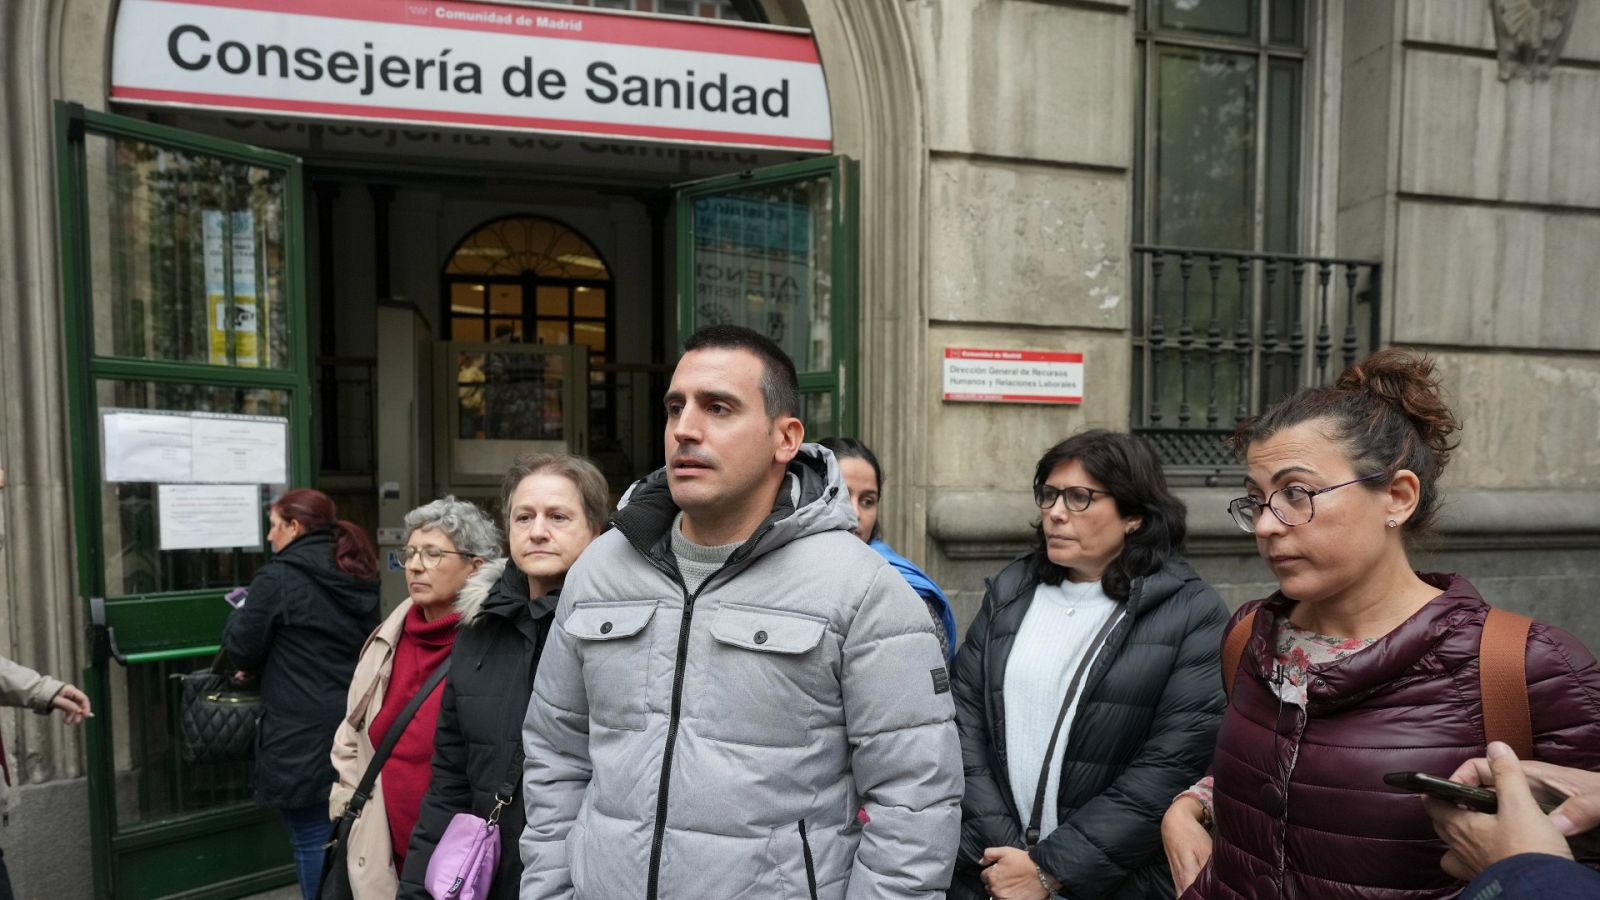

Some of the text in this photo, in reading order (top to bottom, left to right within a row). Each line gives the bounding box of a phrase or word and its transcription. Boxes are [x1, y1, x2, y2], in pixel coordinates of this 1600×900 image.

[435, 6, 583, 31] Comunidad de Madrid
[167, 24, 790, 118] Consejería de Sanidad
[950, 365, 1069, 378] Dirección General de Recursos
[950, 377, 986, 386] Humanos
[995, 378, 1037, 388] Relaciones
[1038, 380, 1077, 389] Laborales
